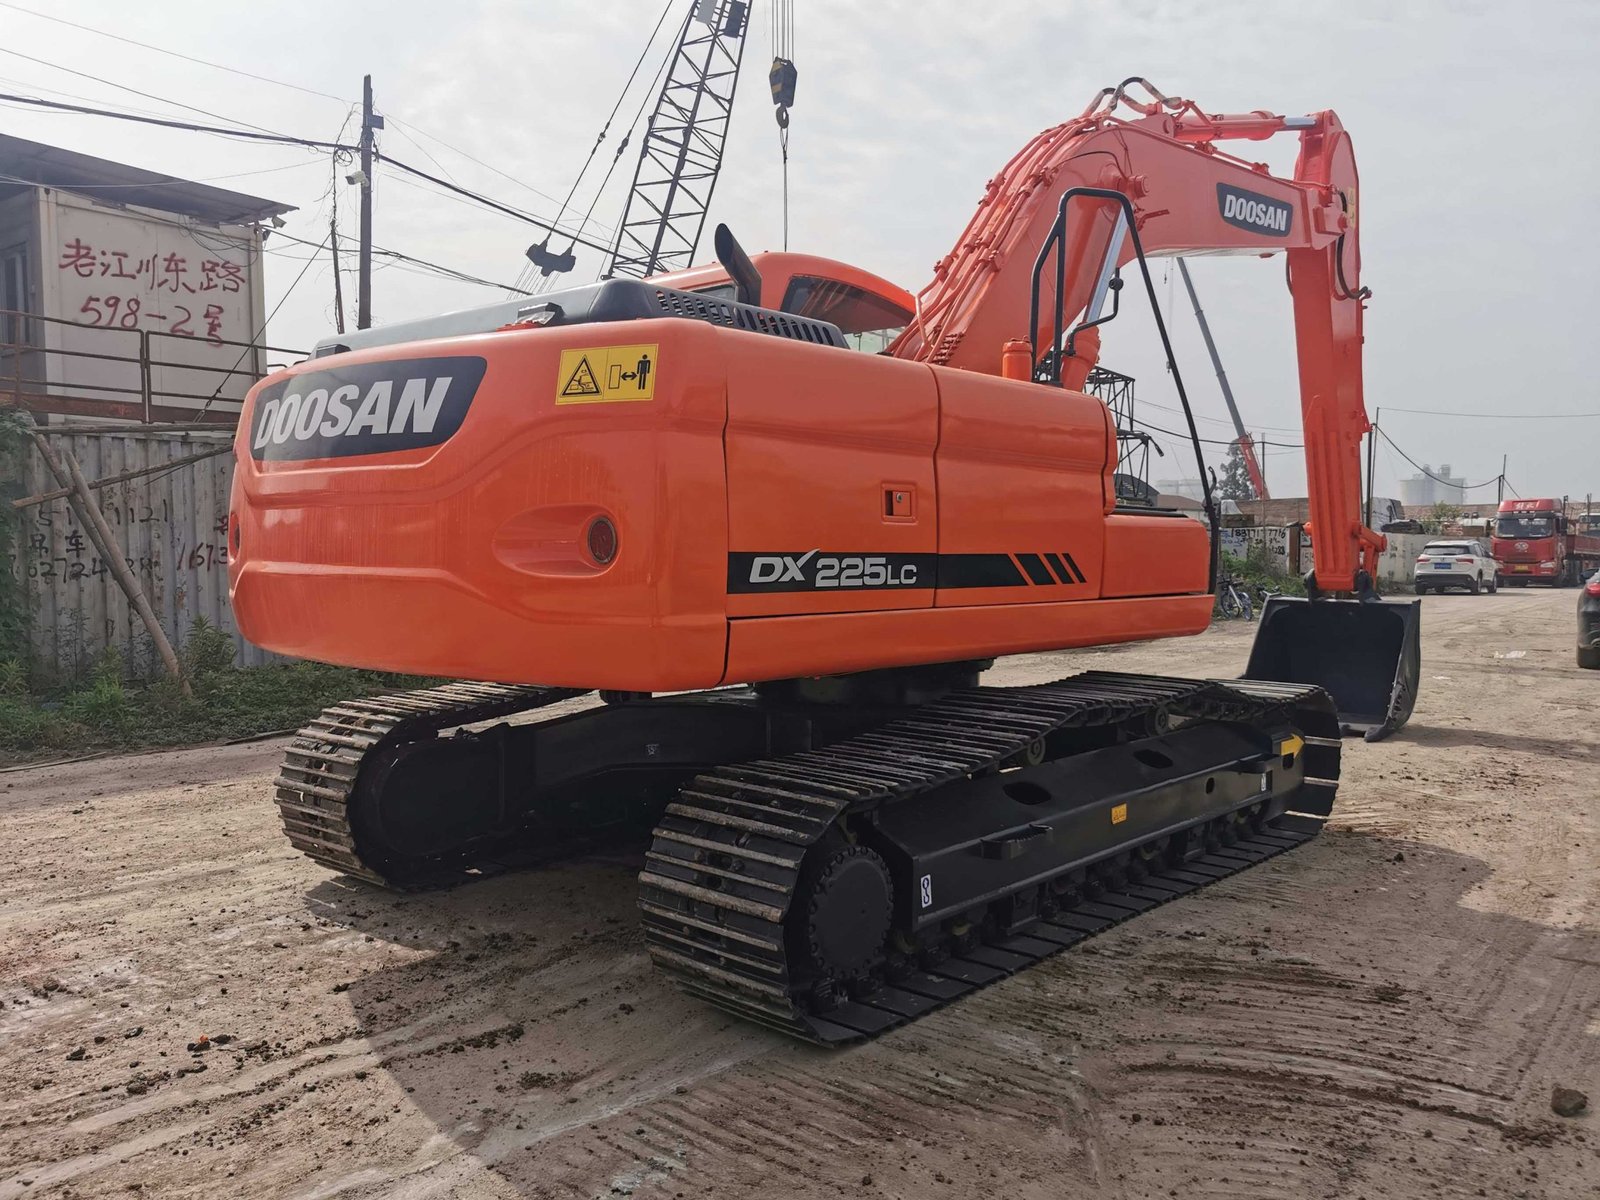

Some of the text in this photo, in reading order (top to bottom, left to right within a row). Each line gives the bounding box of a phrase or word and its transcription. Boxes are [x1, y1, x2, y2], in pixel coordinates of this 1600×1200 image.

[1223, 193, 1288, 232] DOOSAN
[58, 237, 246, 294] 老江川东路
[253, 376, 453, 451] DOOSAN
